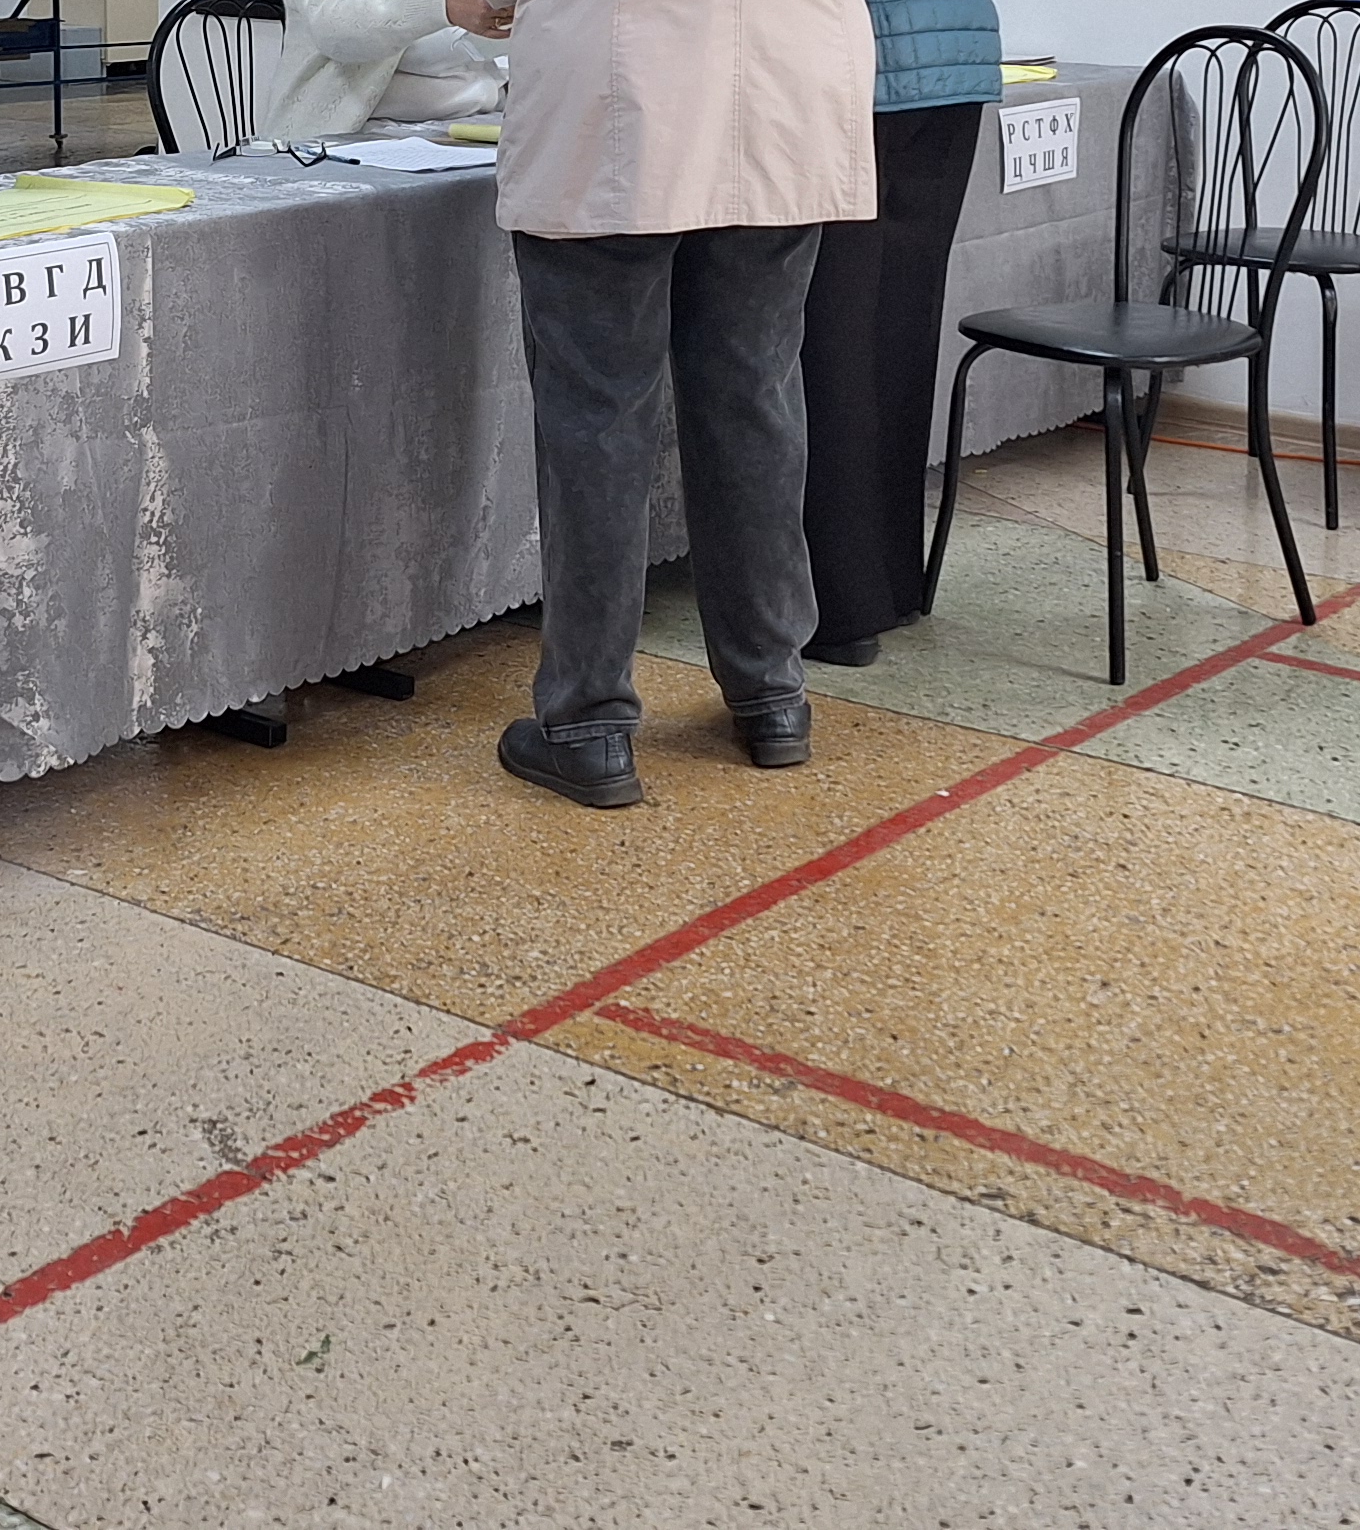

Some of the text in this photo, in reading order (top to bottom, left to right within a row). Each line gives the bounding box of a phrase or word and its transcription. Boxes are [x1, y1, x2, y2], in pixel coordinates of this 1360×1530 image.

[2, 272, 27, 306] В
[44, 264, 64, 298] Г
[82, 257, 107, 300] Д
[30, 322, 49, 356] З
[67, 313, 92, 348] И
